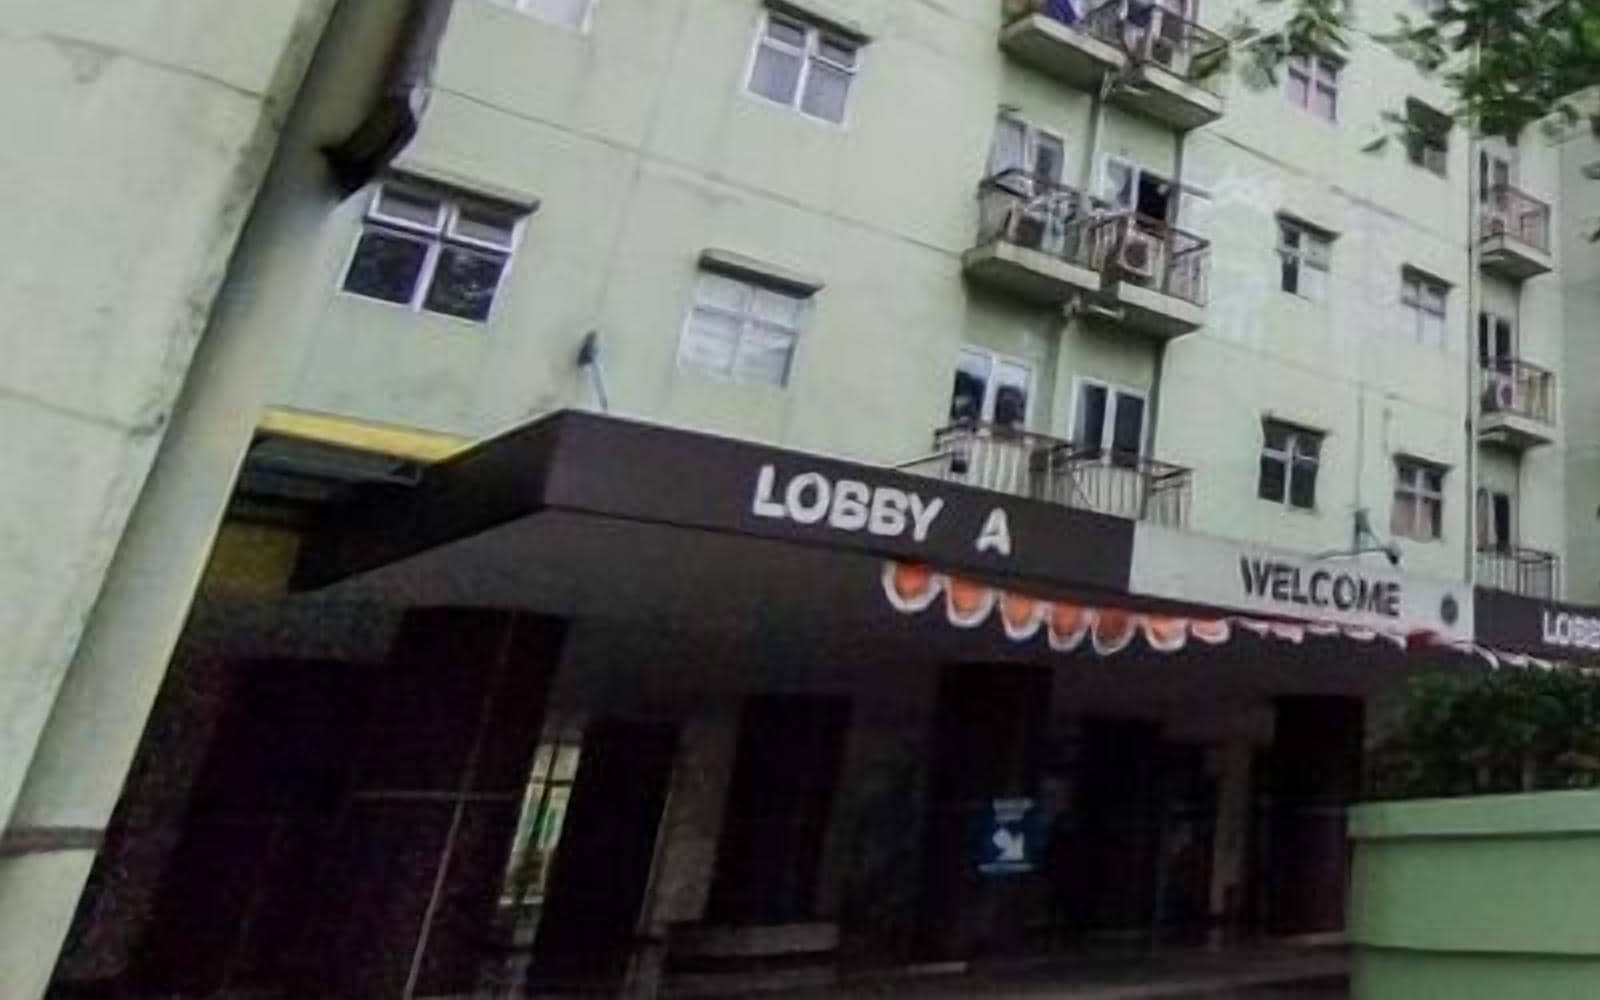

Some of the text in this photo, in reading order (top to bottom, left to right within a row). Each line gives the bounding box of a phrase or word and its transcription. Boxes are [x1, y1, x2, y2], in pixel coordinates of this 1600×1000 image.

[753, 464, 1012, 556] LOBBY A
[1240, 556, 1401, 617] WELCOME
